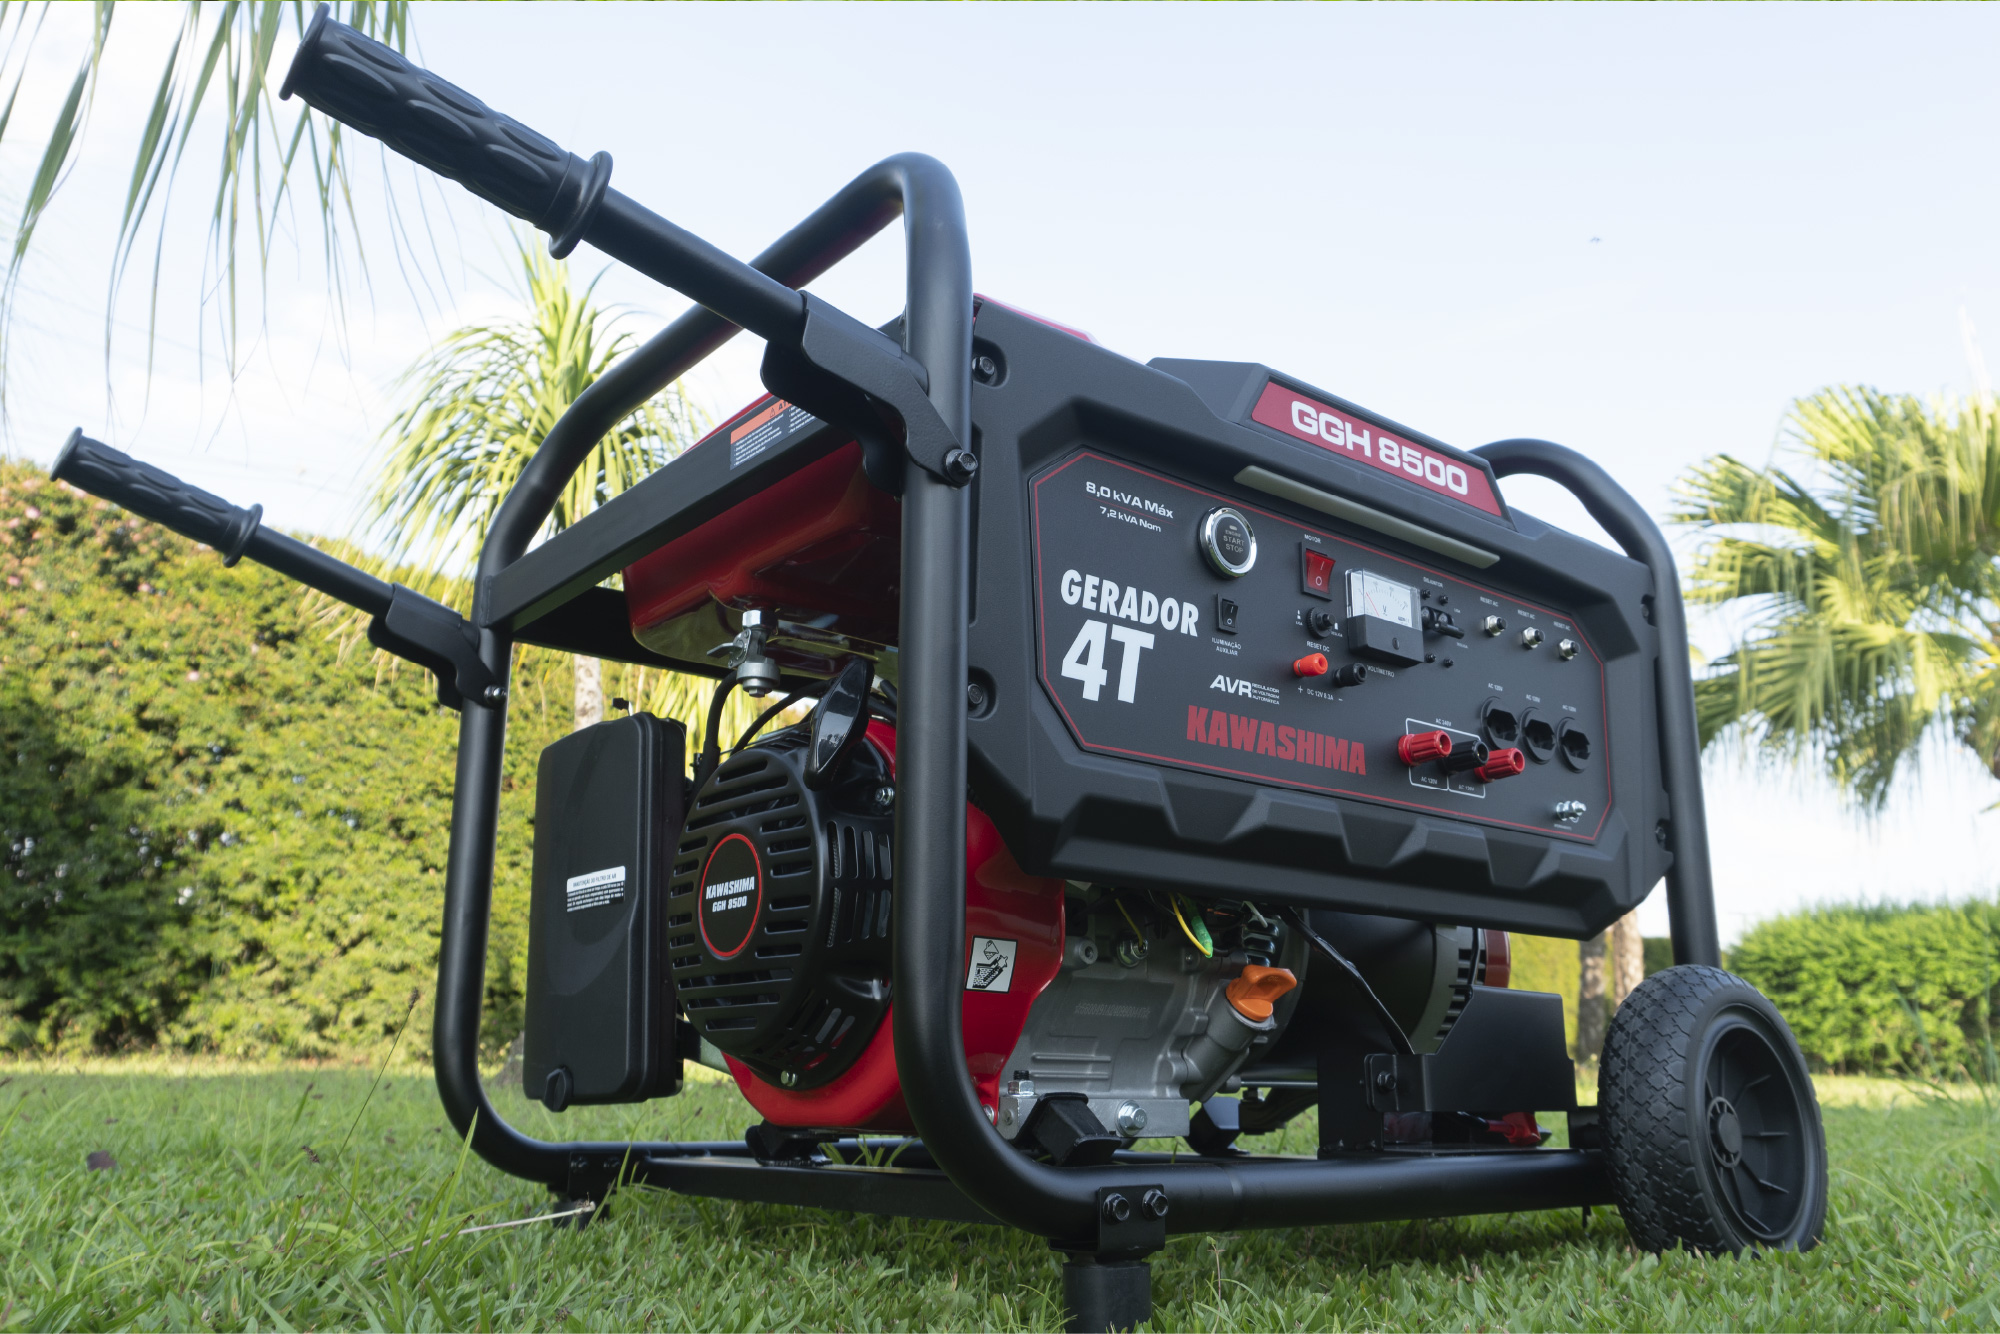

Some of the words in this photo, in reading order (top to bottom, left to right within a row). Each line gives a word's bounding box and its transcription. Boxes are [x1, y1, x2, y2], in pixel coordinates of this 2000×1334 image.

[1291, 400, 1371, 458] GGH
[1378, 436, 1468, 496] 8500
[1086, 481, 1111, 498] 8,0
[1113, 490, 1143, 509] kVA
[1144, 499, 1174, 519] Máx
[1099, 505, 1117, 518] 7,2
[1118, 511, 1138, 525] kVA
[1139, 518, 1162, 532] Nom
[1223, 535, 1245, 546] START
[1225, 543, 1244, 553] STOP
[1061, 569, 1199, 637] GERADOR
[1211, 636, 1242, 650] ILUMINAÇÃO
[1306, 640, 1322, 650] RESET
[1061, 619, 1155, 704] 4T
[1210, 674, 1252, 698] AVR
[1186, 704, 1367, 776] KAWASHIMA
[706, 876, 755, 900] KAWASHIMA
[712, 900, 726, 912] GGH
[728, 896, 747, 910] 8500
